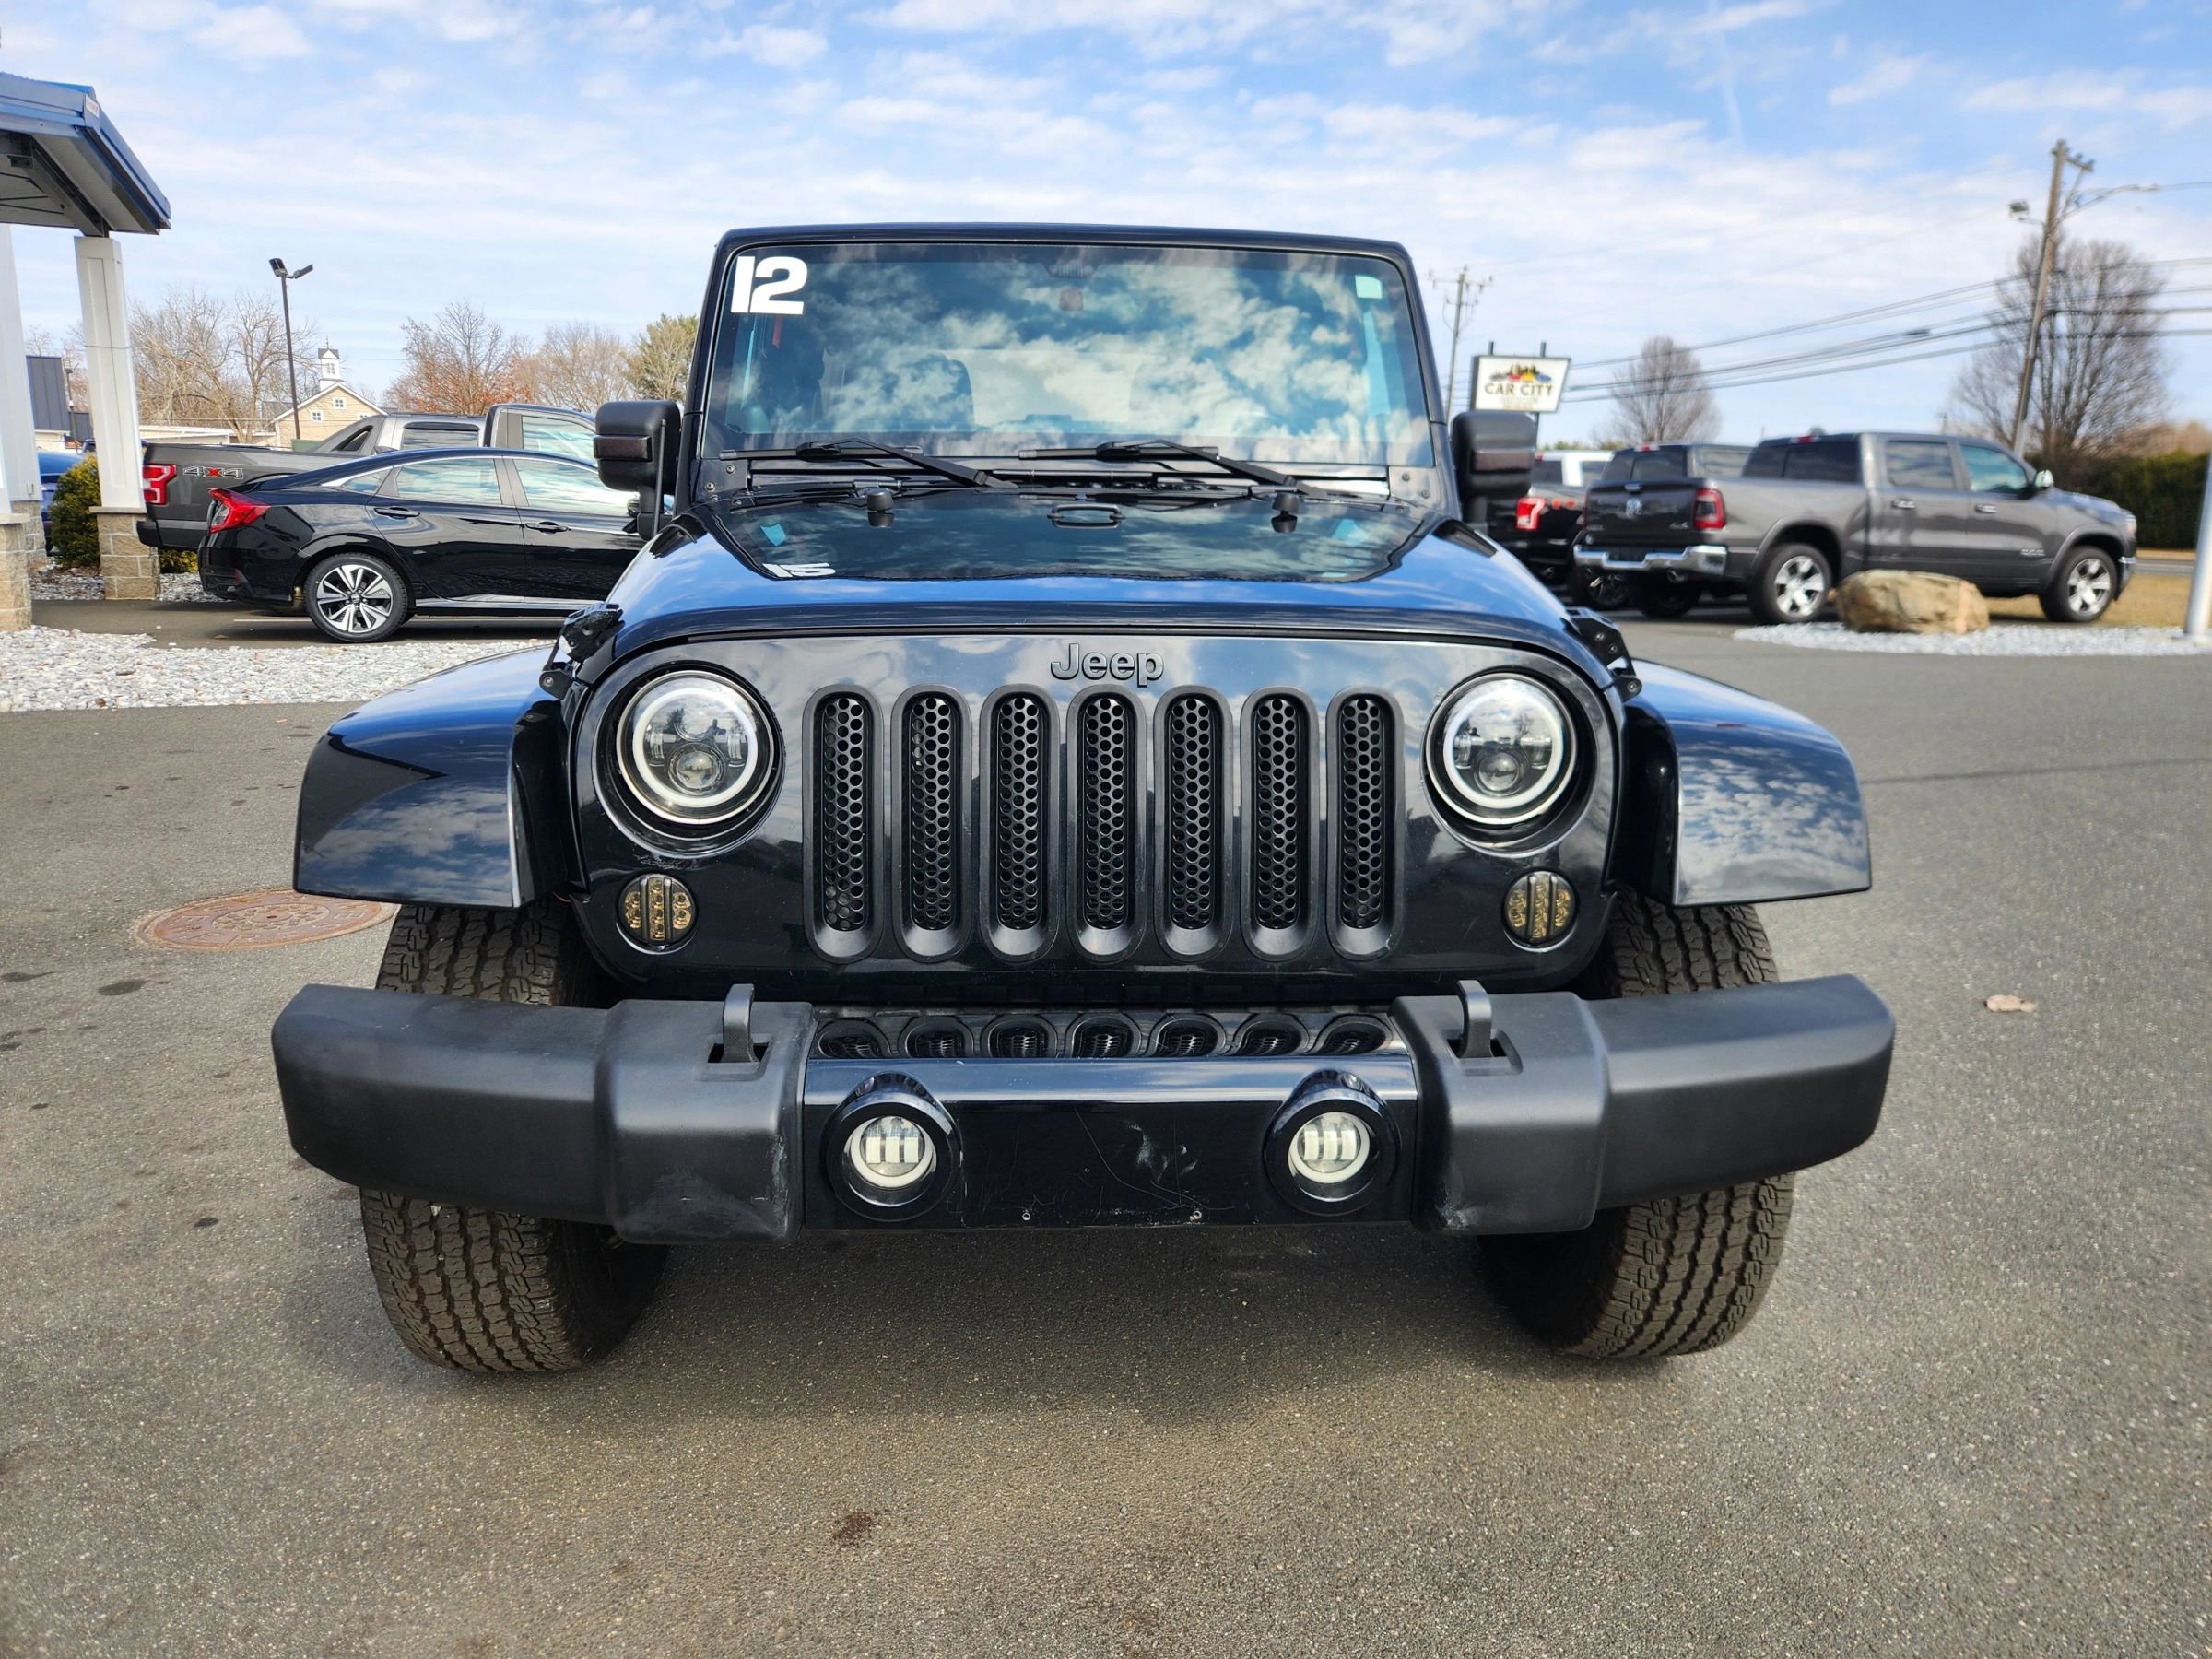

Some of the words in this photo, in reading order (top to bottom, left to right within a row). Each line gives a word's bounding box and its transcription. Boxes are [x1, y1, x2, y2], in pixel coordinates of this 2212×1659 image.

[730, 255, 808, 315] 12
[1484, 382, 1514, 395] CAR
[1520, 383, 1553, 396] CITY
[1050, 642, 1164, 688] Jeep
